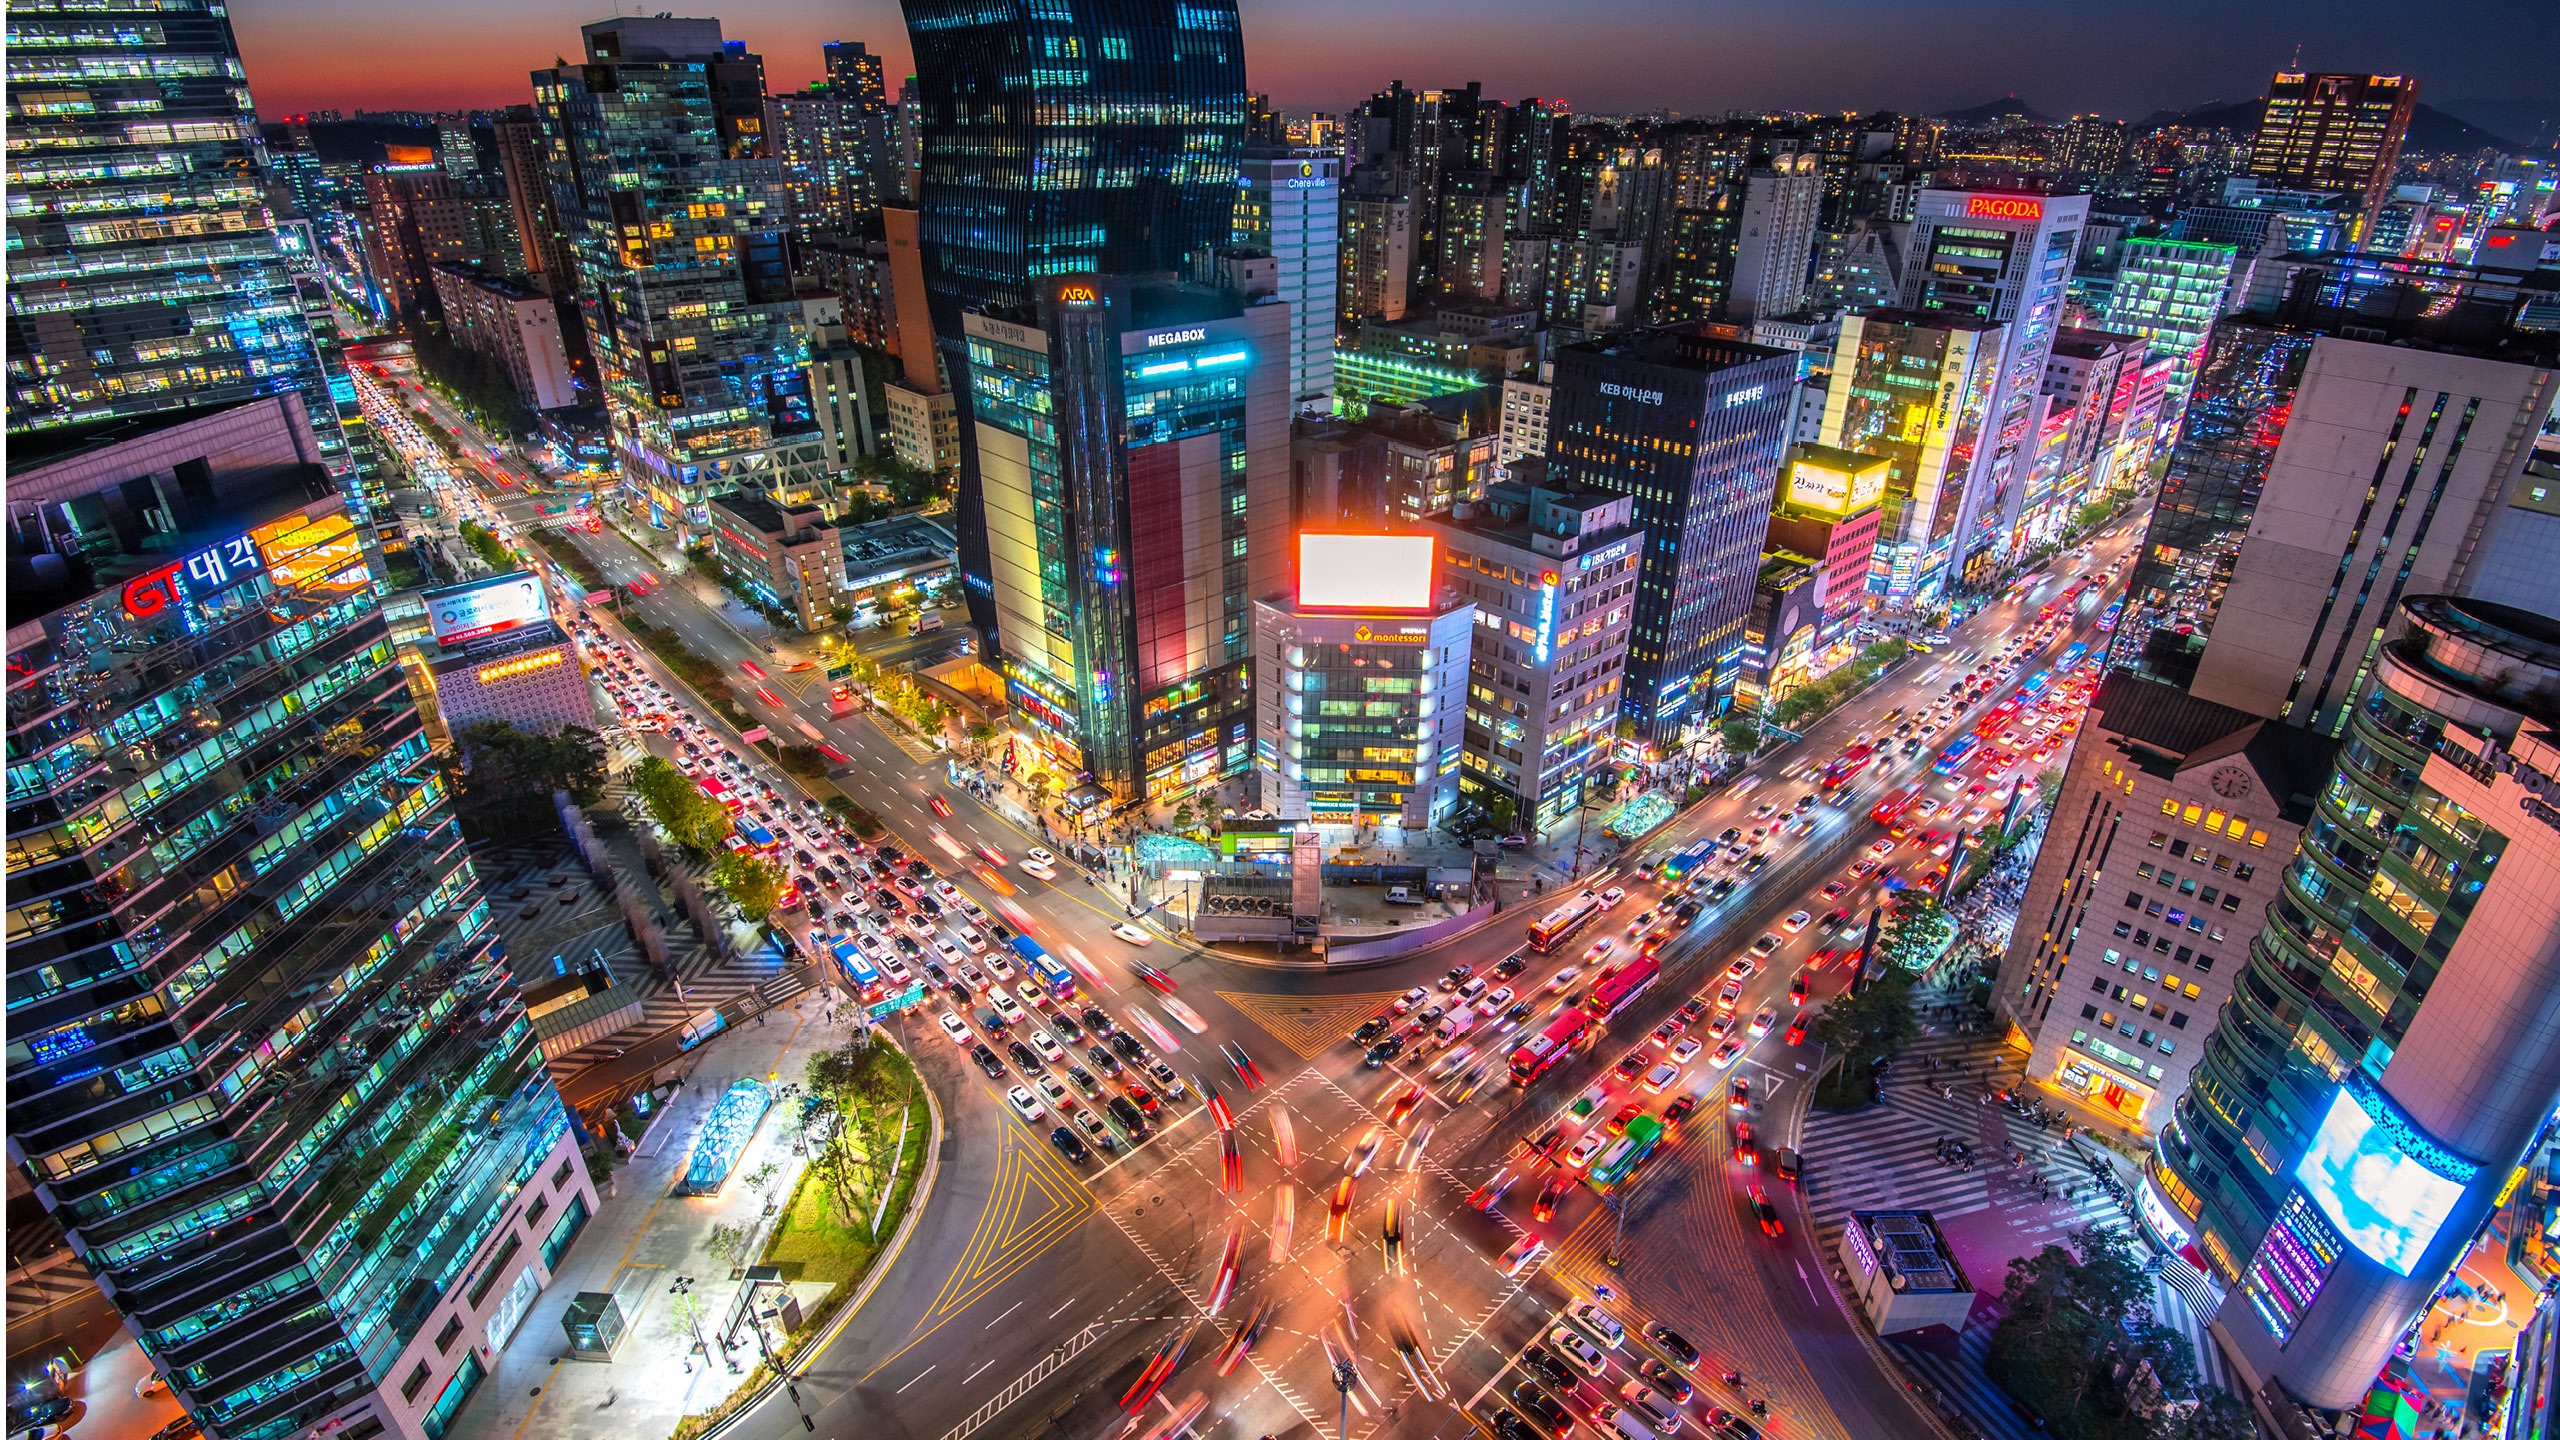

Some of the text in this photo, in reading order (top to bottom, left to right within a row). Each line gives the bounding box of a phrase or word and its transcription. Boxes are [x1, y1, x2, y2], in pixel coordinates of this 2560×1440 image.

[1288, 177, 1326, 188] Chereville
[1969, 198, 2041, 218] PAGODA
[1061, 288, 1095, 300] ARA
[1148, 328, 1206, 347] MEGABOX
[1600, 382, 1663, 406] KEB 하나은행
[188, 535, 258, 585] 대각
[124, 562, 183, 617] GT
[1373, 633, 1427, 643] montessori
[1846, 1226, 1871, 1277] SQUARE
[1849, 1221, 1875, 1268] GANGNAM
